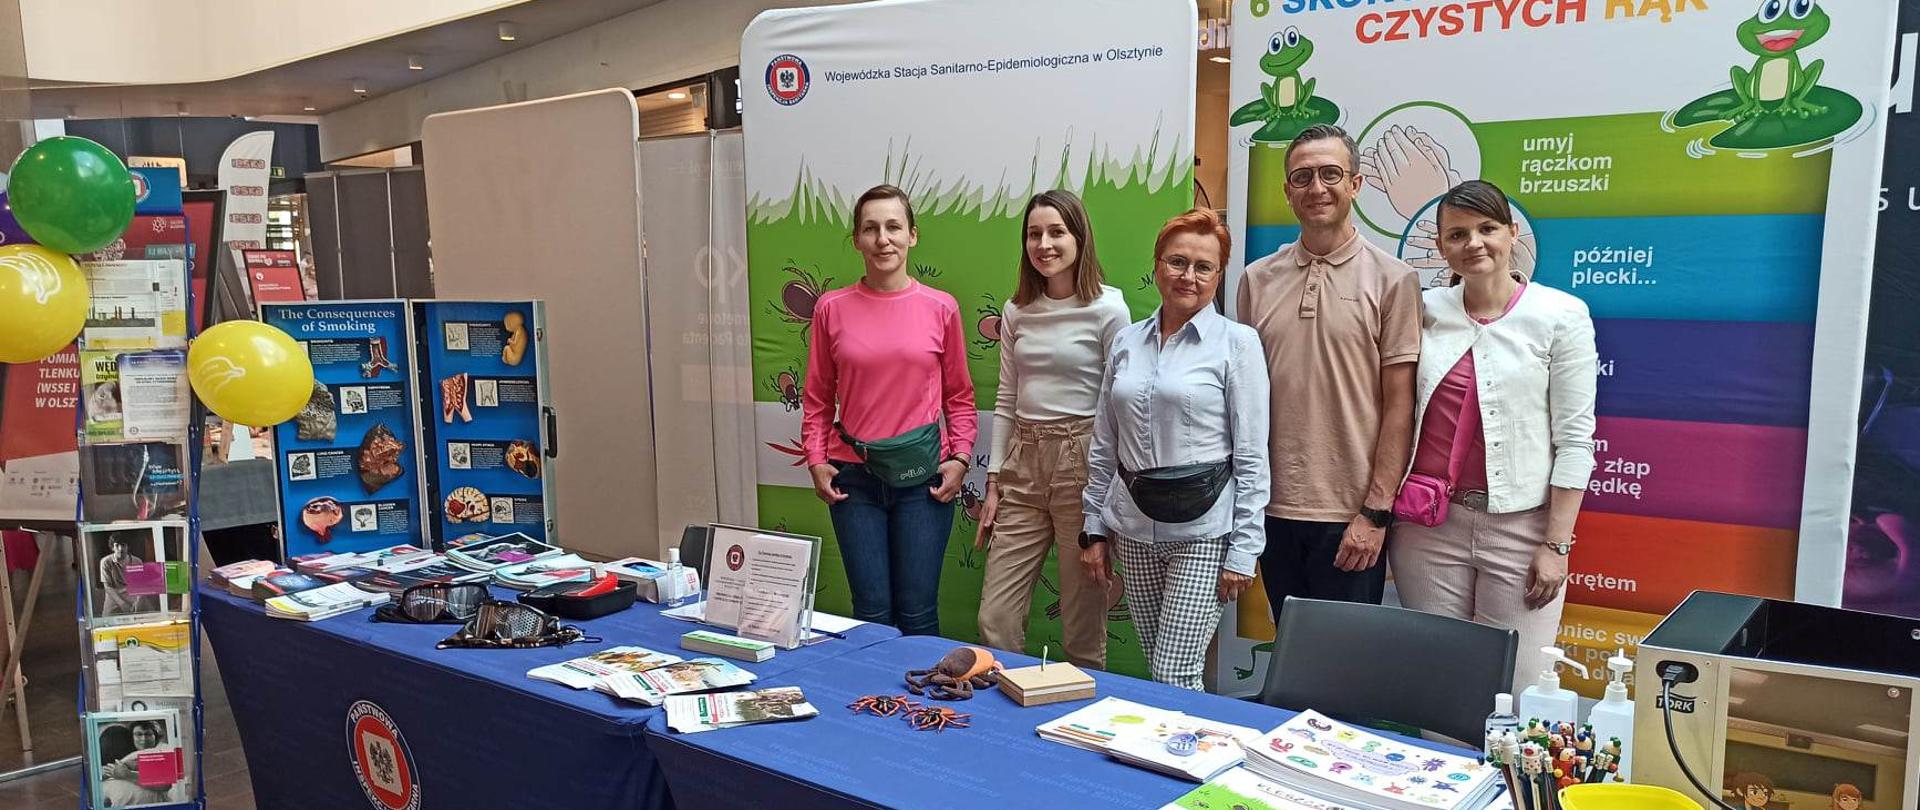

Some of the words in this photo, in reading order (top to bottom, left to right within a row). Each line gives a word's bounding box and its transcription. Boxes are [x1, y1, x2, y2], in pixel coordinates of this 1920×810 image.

[1356, 0, 1588, 44] CZYSTYCH
[824, 68, 891, 83] Wojewódzka
[894, 66, 928, 80] Stacja
[930, 54, 1089, 75] Sanitarno-Epidemiologiczna
[1092, 53, 1103, 62] w
[1106, 44, 1164, 61] Olsztynie
[1523, 132, 1574, 154] umyj
[1521, 154, 1612, 176] rączkom
[1520, 173, 1610, 194] brzuszki
[1573, 246, 1654, 268] później
[1571, 267, 1657, 289] plecki...
[278, 308, 303, 320] The
[306, 308, 396, 321] Consequences
[301, 321, 315, 332] of
[318, 321, 376, 334] Smoking
[41, 353, 79, 364] POMIA
[36, 382, 71, 394] (WSSE
[35, 398, 48, 408] W
[900, 466, 926, 481] FILA
[1604, 457, 1651, 479] złap
[1558, 623, 1608, 643] niec
